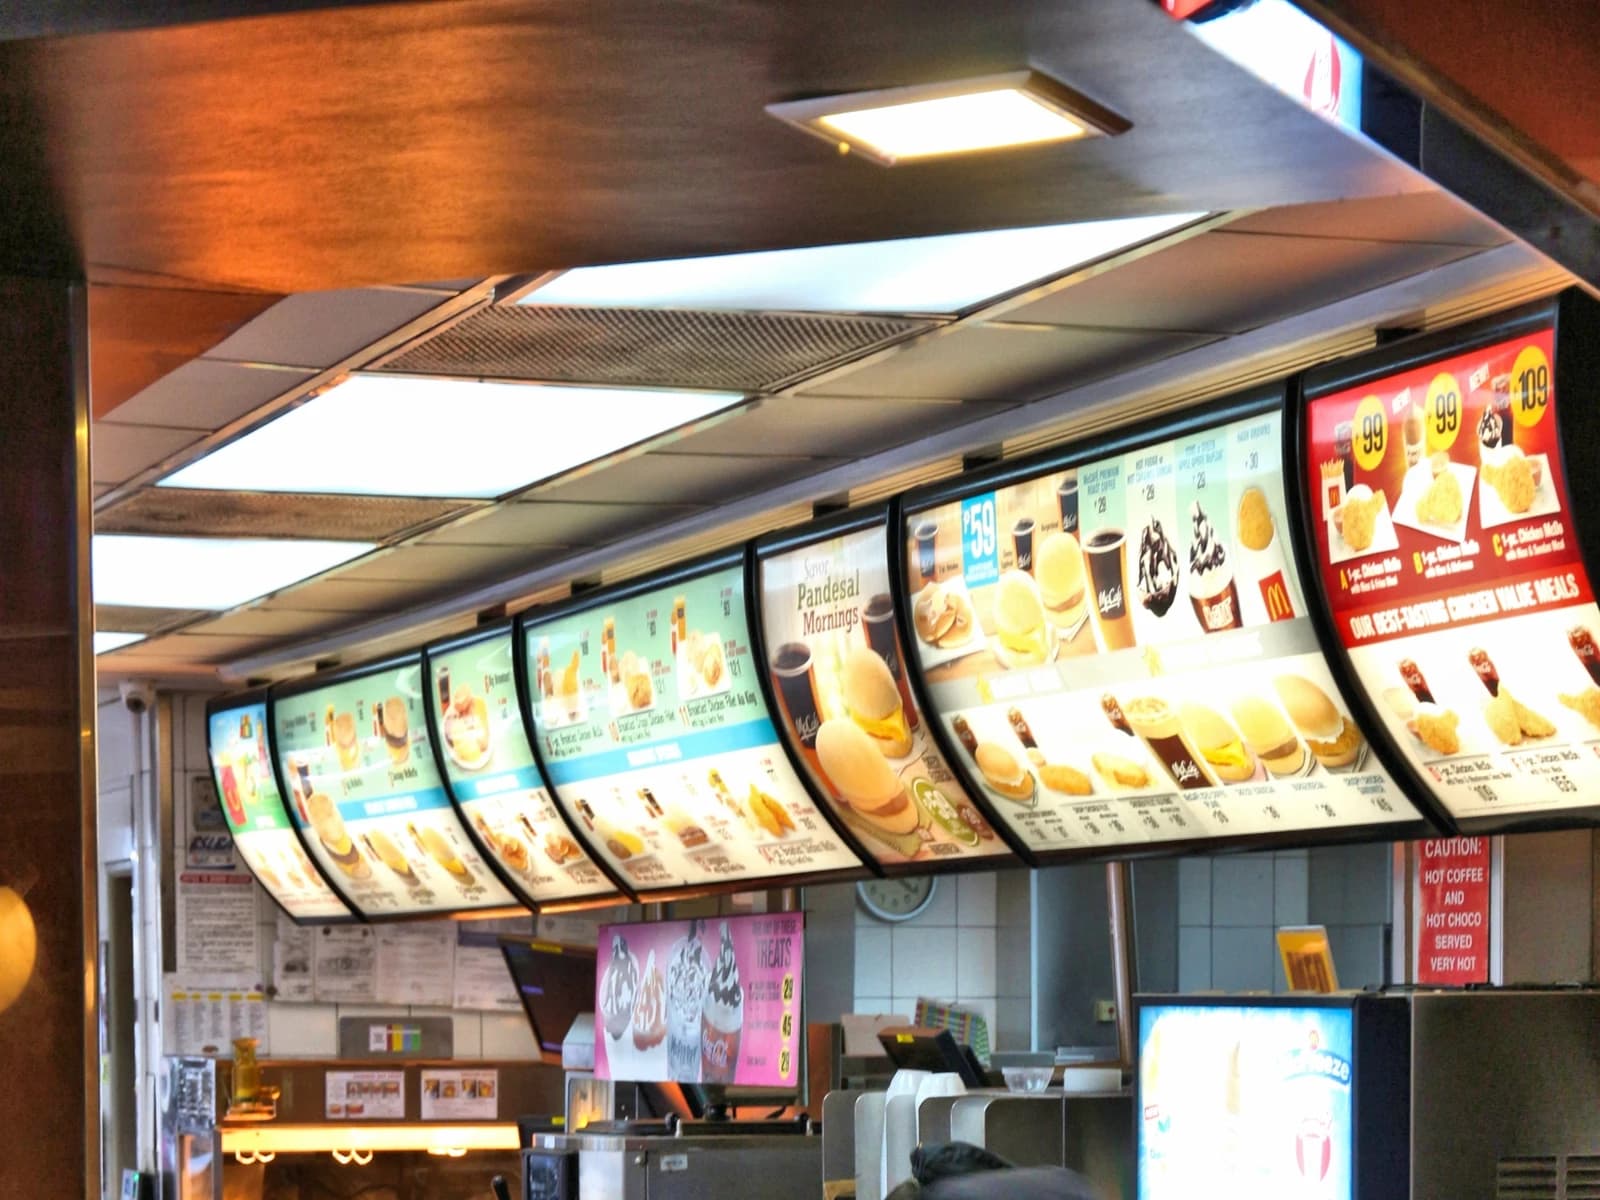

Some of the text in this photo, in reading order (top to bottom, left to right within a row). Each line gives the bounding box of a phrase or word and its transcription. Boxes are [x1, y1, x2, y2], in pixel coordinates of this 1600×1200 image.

[1518, 365, 1548, 412] 109
[1435, 391, 1458, 435] 99
[1362, 412, 1384, 455] 99
[797, 569, 860, 611] Pandesal
[1349, 615, 1376, 640] OUR
[1496, 579, 1537, 612] VALUE
[1534, 572, 1581, 606] MEALS
[803, 604, 859, 637] Mornings
[1425, 839, 1482, 859] CAUTION:
[1425, 867, 1483, 884] HOT COFFEE
[1444, 890, 1465, 905] AND
[1426, 912, 1482, 929] HOT CHOCO
[756, 937, 792, 969] TREATS
[1435, 934, 1473, 950] SERVED
[1430, 956, 1477, 971] VERY HOT
[782, 1015, 792, 1036] 45
